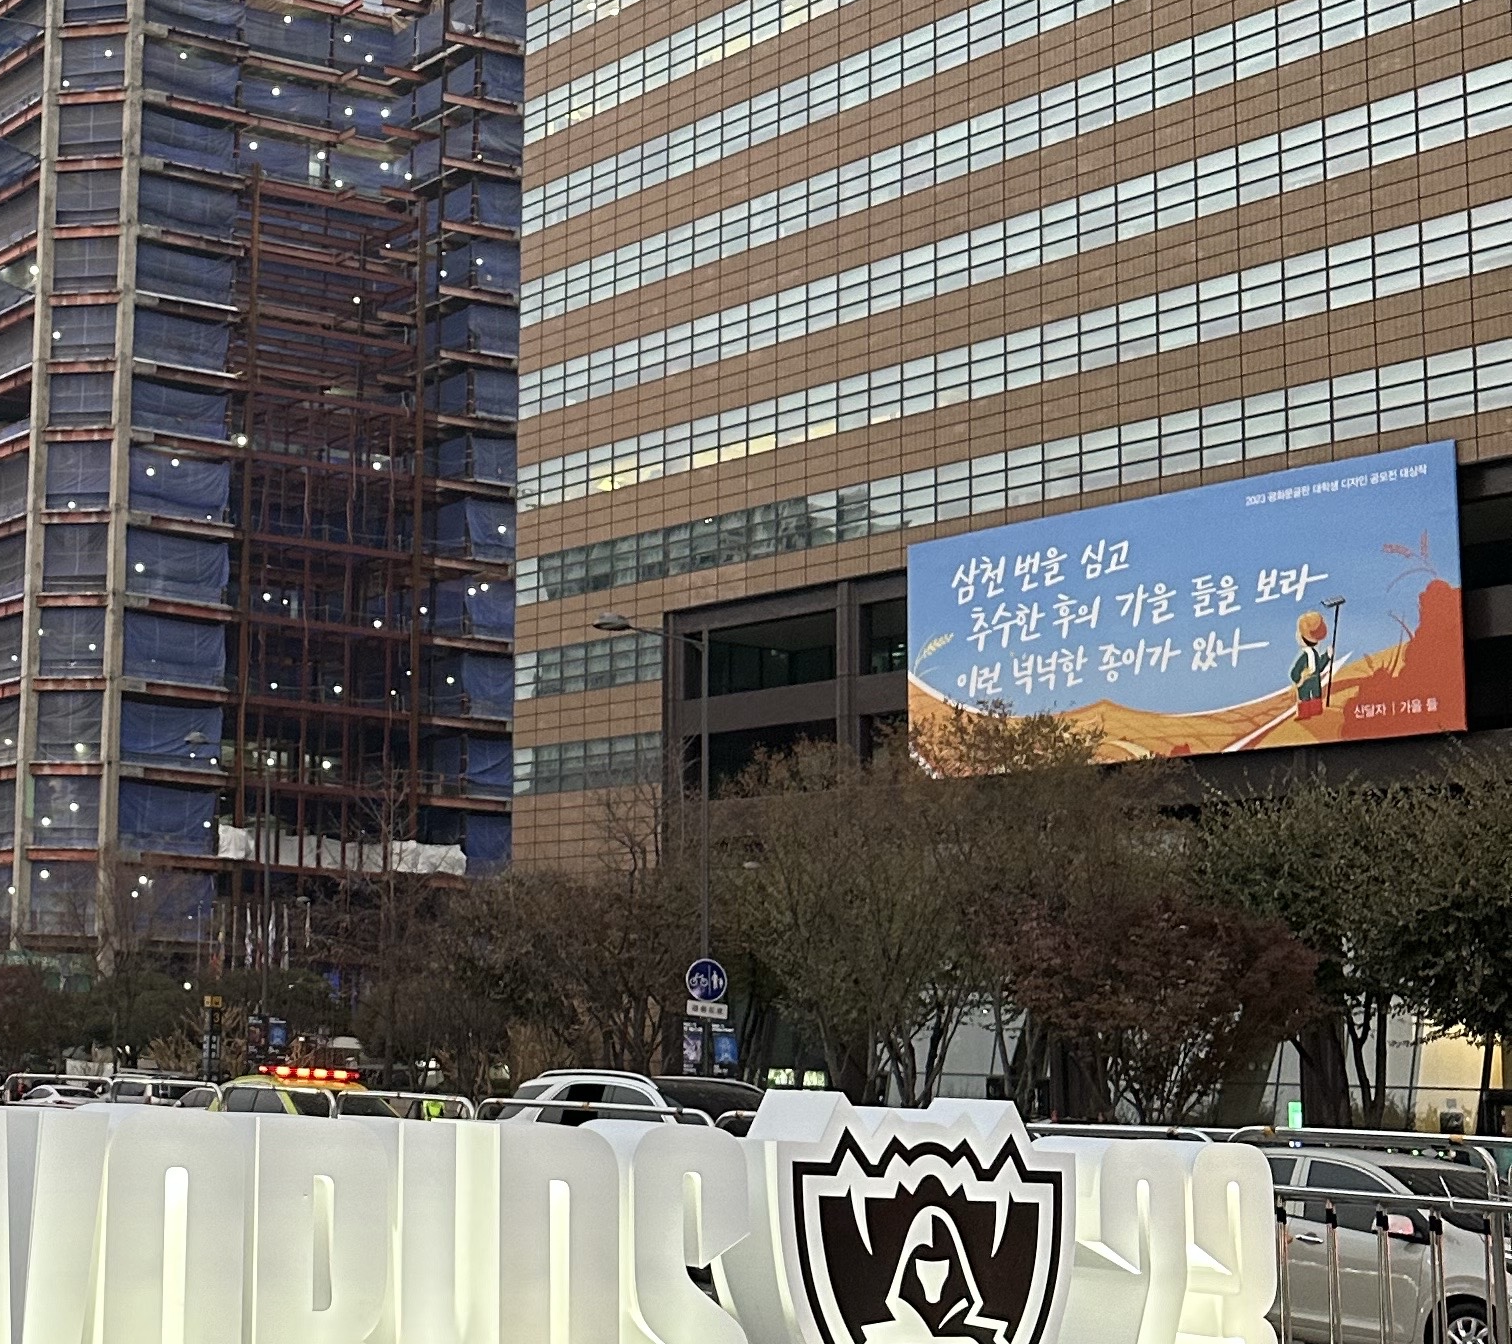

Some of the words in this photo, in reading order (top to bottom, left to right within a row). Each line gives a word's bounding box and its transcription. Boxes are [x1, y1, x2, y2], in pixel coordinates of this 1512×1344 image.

[1341, 474, 1368, 489] 디자인
[951, 556, 1006, 605] 삼천
[1014, 546, 1068, 593] 번을
[1080, 539, 1130, 580] 심고
[966, 602, 1045, 652] 추수한
[1052, 593, 1101, 639] 후의
[1115, 583, 1177, 628] 가을
[1190, 574, 1242, 620] 들을
[957, 661, 1004, 698] 이런
[1012, 645, 1088, 697] 넉넉한
[1098, 637, 1181, 684] 종이가
[1354, 702, 1387, 719] 신달자
[1400, 698, 1422, 714] 가을
